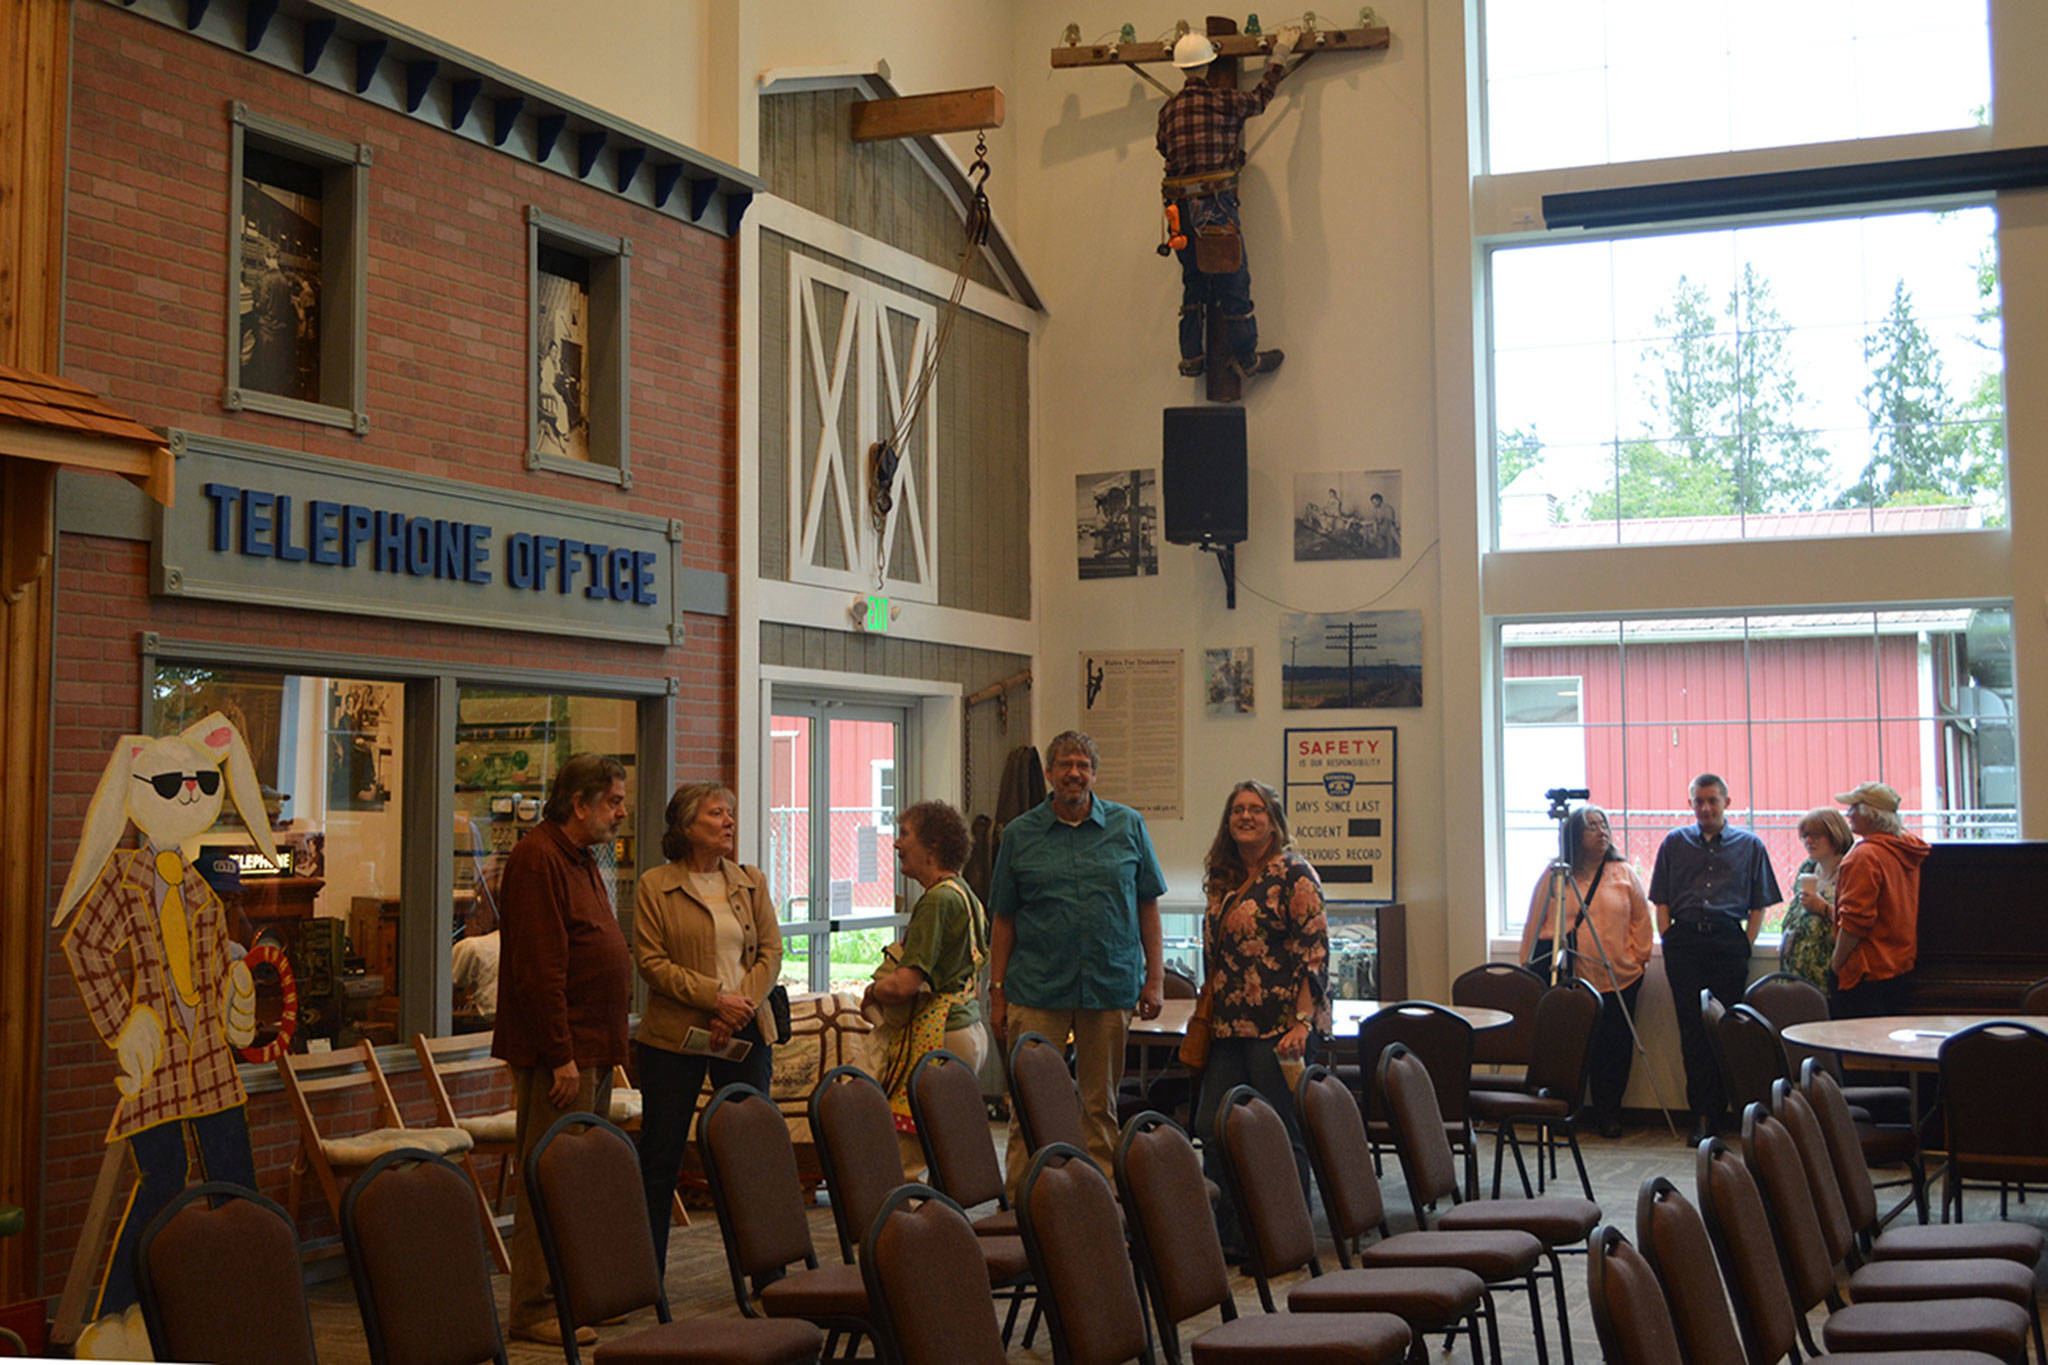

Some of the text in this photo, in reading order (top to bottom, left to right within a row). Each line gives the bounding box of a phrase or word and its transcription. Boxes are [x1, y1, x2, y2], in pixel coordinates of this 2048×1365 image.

[205, 483, 657, 605] TELEPHONE OFFICE
[868, 597, 888, 631] EXIT
[1299, 740, 1379, 755] SAFETY
[1298, 758, 1381, 768] IS OUR RESPONSIBILITY
[1295, 800, 1380, 813] DAYS SINCE LAST
[1295, 825, 1343, 838] ACCIDENT
[1346, 847, 1382, 860] RECORD
